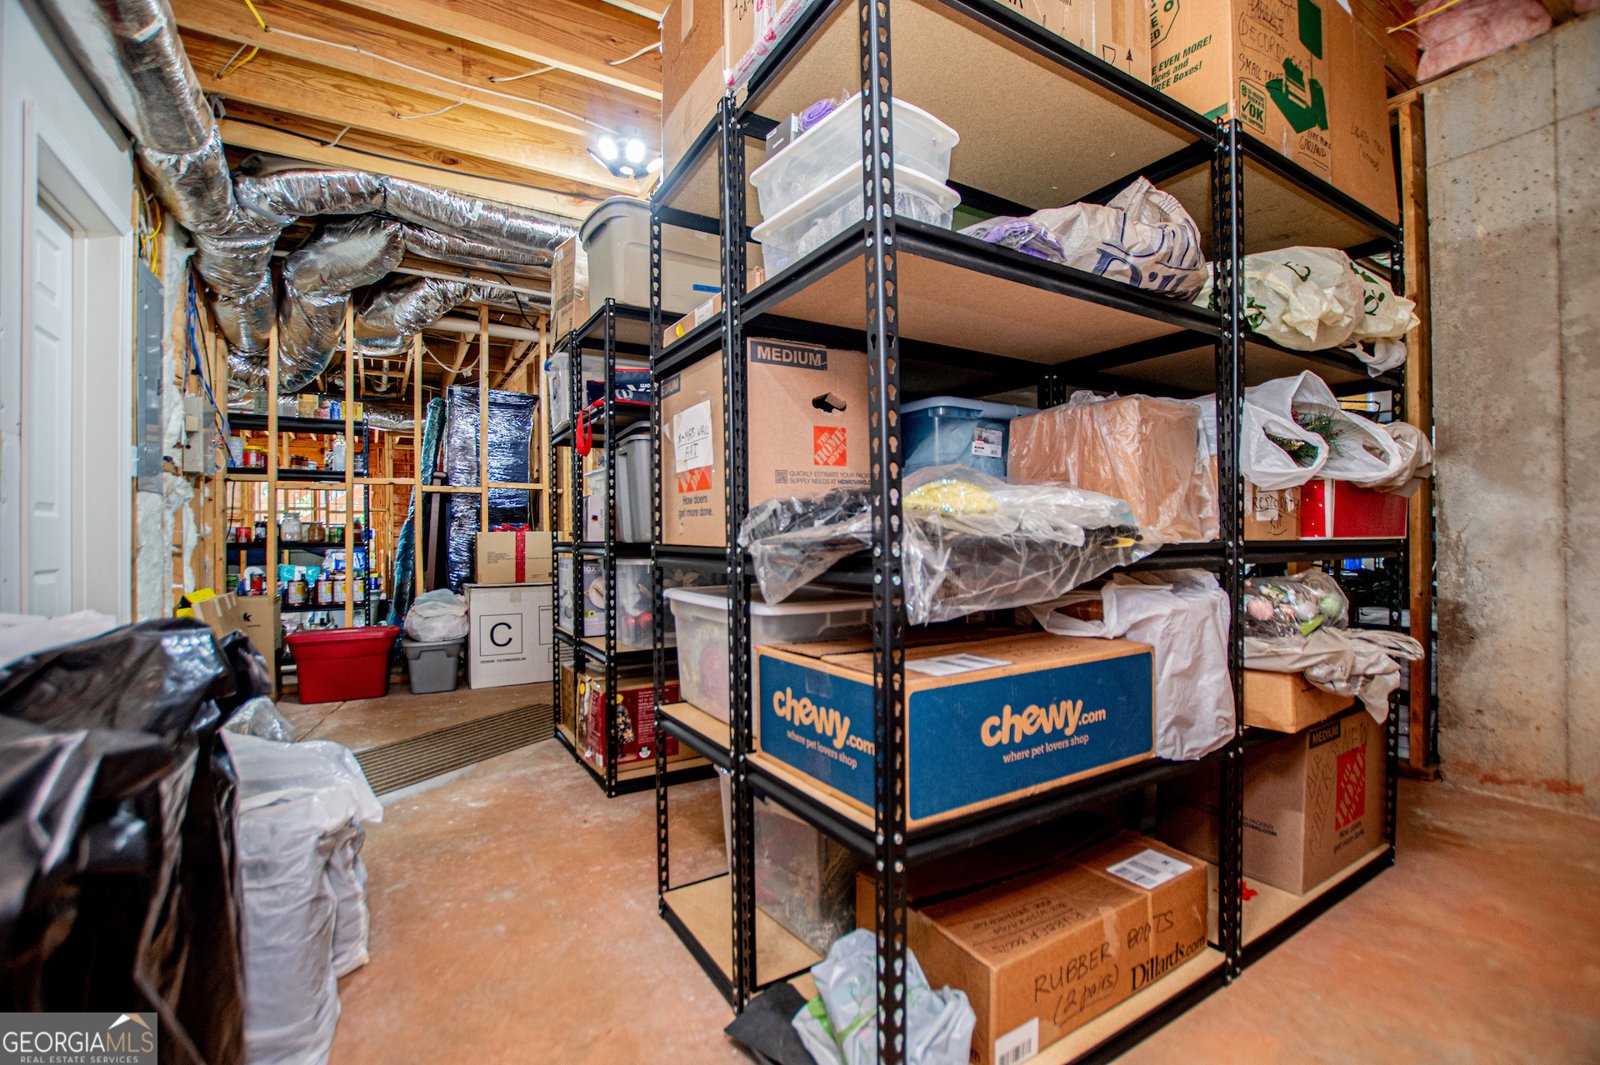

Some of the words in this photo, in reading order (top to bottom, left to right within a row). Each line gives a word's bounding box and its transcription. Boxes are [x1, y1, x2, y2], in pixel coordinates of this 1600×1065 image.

[1159, 52, 1181, 71] EVEN
[1183, 34, 1212, 58] MORE!
[1152, 70, 1171, 86] rices
[1173, 58, 1189, 73] and
[1173, 60, 1202, 84] Boxes!
[1250, 103, 1264, 123] OK
[757, 345, 822, 367] MEDIUM
[661, 375, 680, 397] EDIUM
[814, 429, 846, 465] HOME
[789, 470, 813, 478] QUICKLY
[682, 496, 693, 505] How
[694, 495, 708, 505] doers
[678, 511, 686, 520] get
[687, 510, 698, 518] more
[699, 508, 714, 517] done.
[490, 622, 513, 647] C
[773, 686, 875, 757] chewy.com
[981, 699, 1107, 747] chewy.com
[1312, 724, 1339, 744] MEDIUM
[786, 730, 805, 745] where
[806, 739, 817, 749] pet
[817, 741, 838, 760] lovers
[839, 752, 858, 770] shop
[1003, 750, 1029, 764] where
[1031, 745, 1045, 759] pet
[1045, 740, 1070, 753] lovers
[1070, 734, 1090, 746] shop
[1034, 942, 1112, 1003] RUBBER
[1126, 910, 1174, 950] BOOTS
[1130, 935, 1206, 992] Dillards.com
